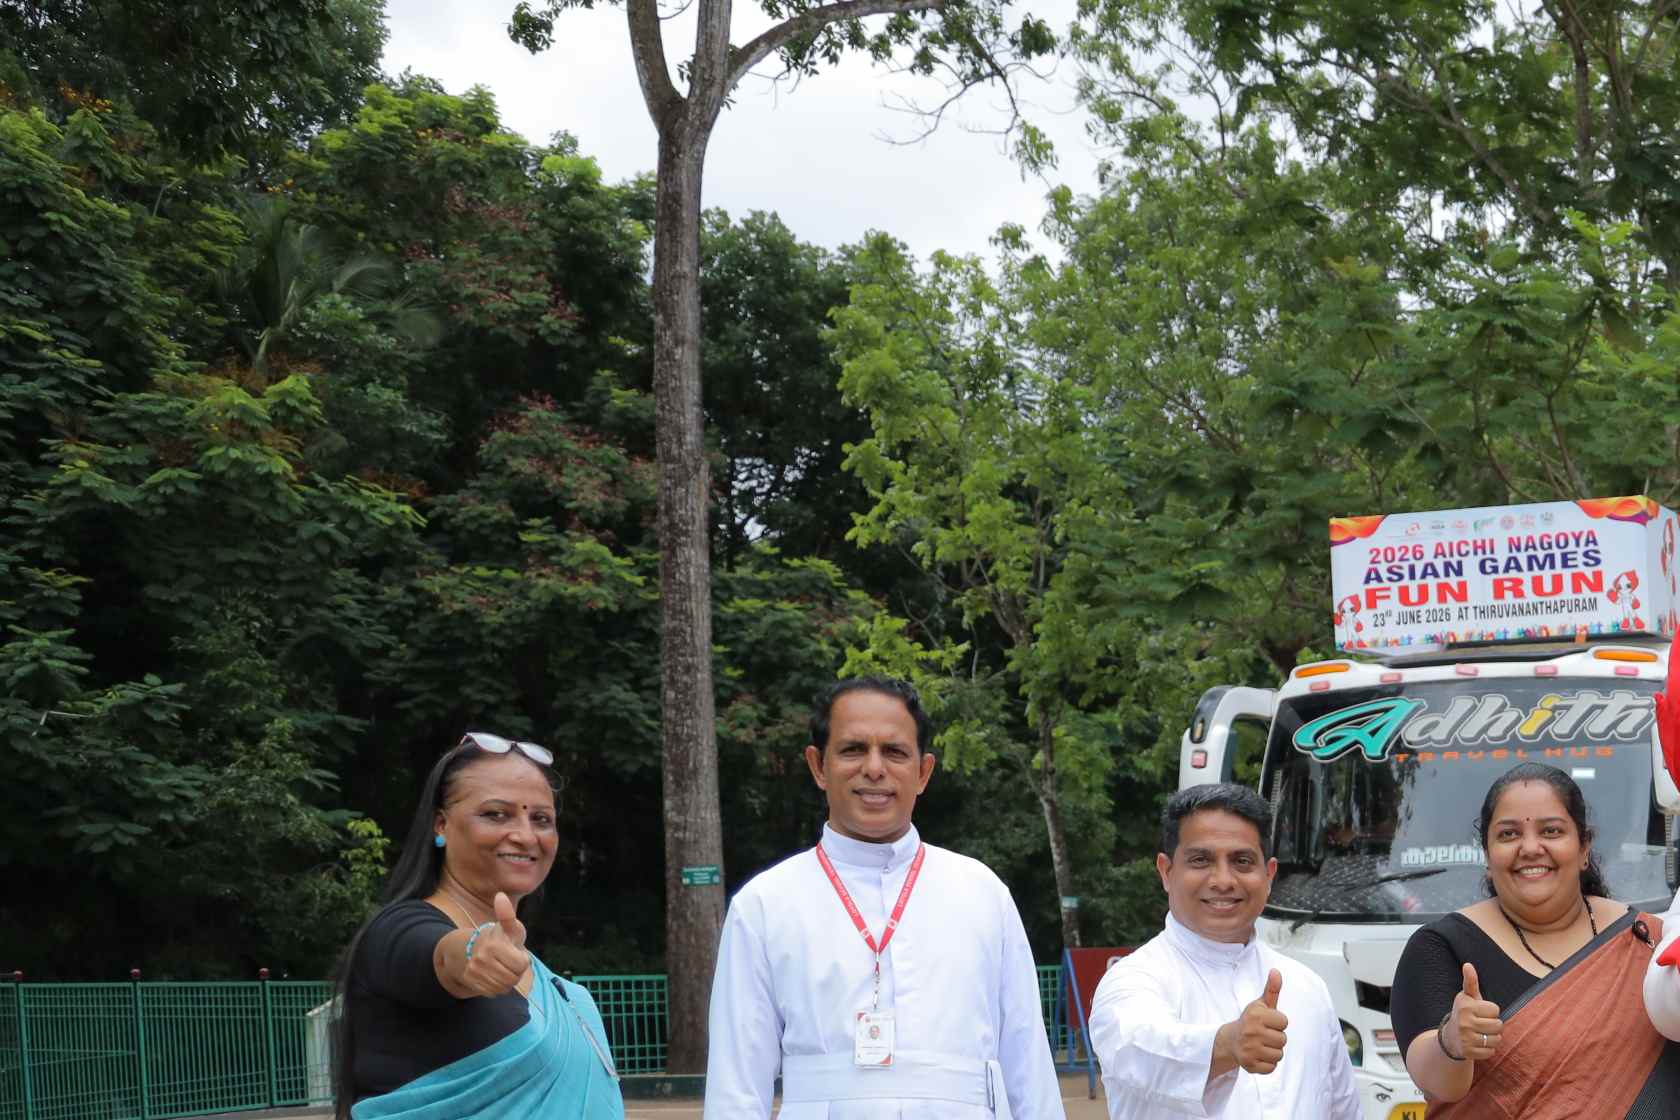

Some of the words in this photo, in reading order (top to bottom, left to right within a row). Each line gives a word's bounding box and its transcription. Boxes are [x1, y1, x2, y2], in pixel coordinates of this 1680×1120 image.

[1369, 544, 1424, 564] 2026
[1433, 539, 1495, 559] AICHI
[1508, 530, 1599, 552] NAGOYA
[1364, 559, 1463, 585] ASIAN
[1479, 549, 1602, 576] GAMES
[1365, 580, 1468, 609] FUN
[1493, 570, 1604, 600] RUN
[1396, 610, 1422, 626] JUNE
[1426, 607, 1451, 623] 2026
[1458, 606, 1470, 620] AT
[1472, 597, 1598, 620] THIRUVANANTHAPURAM
[1292, 690, 1655, 762] Adhith
[1395, 748, 1528, 762] TRAVEL
[1545, 747, 1613, 758] HUB
